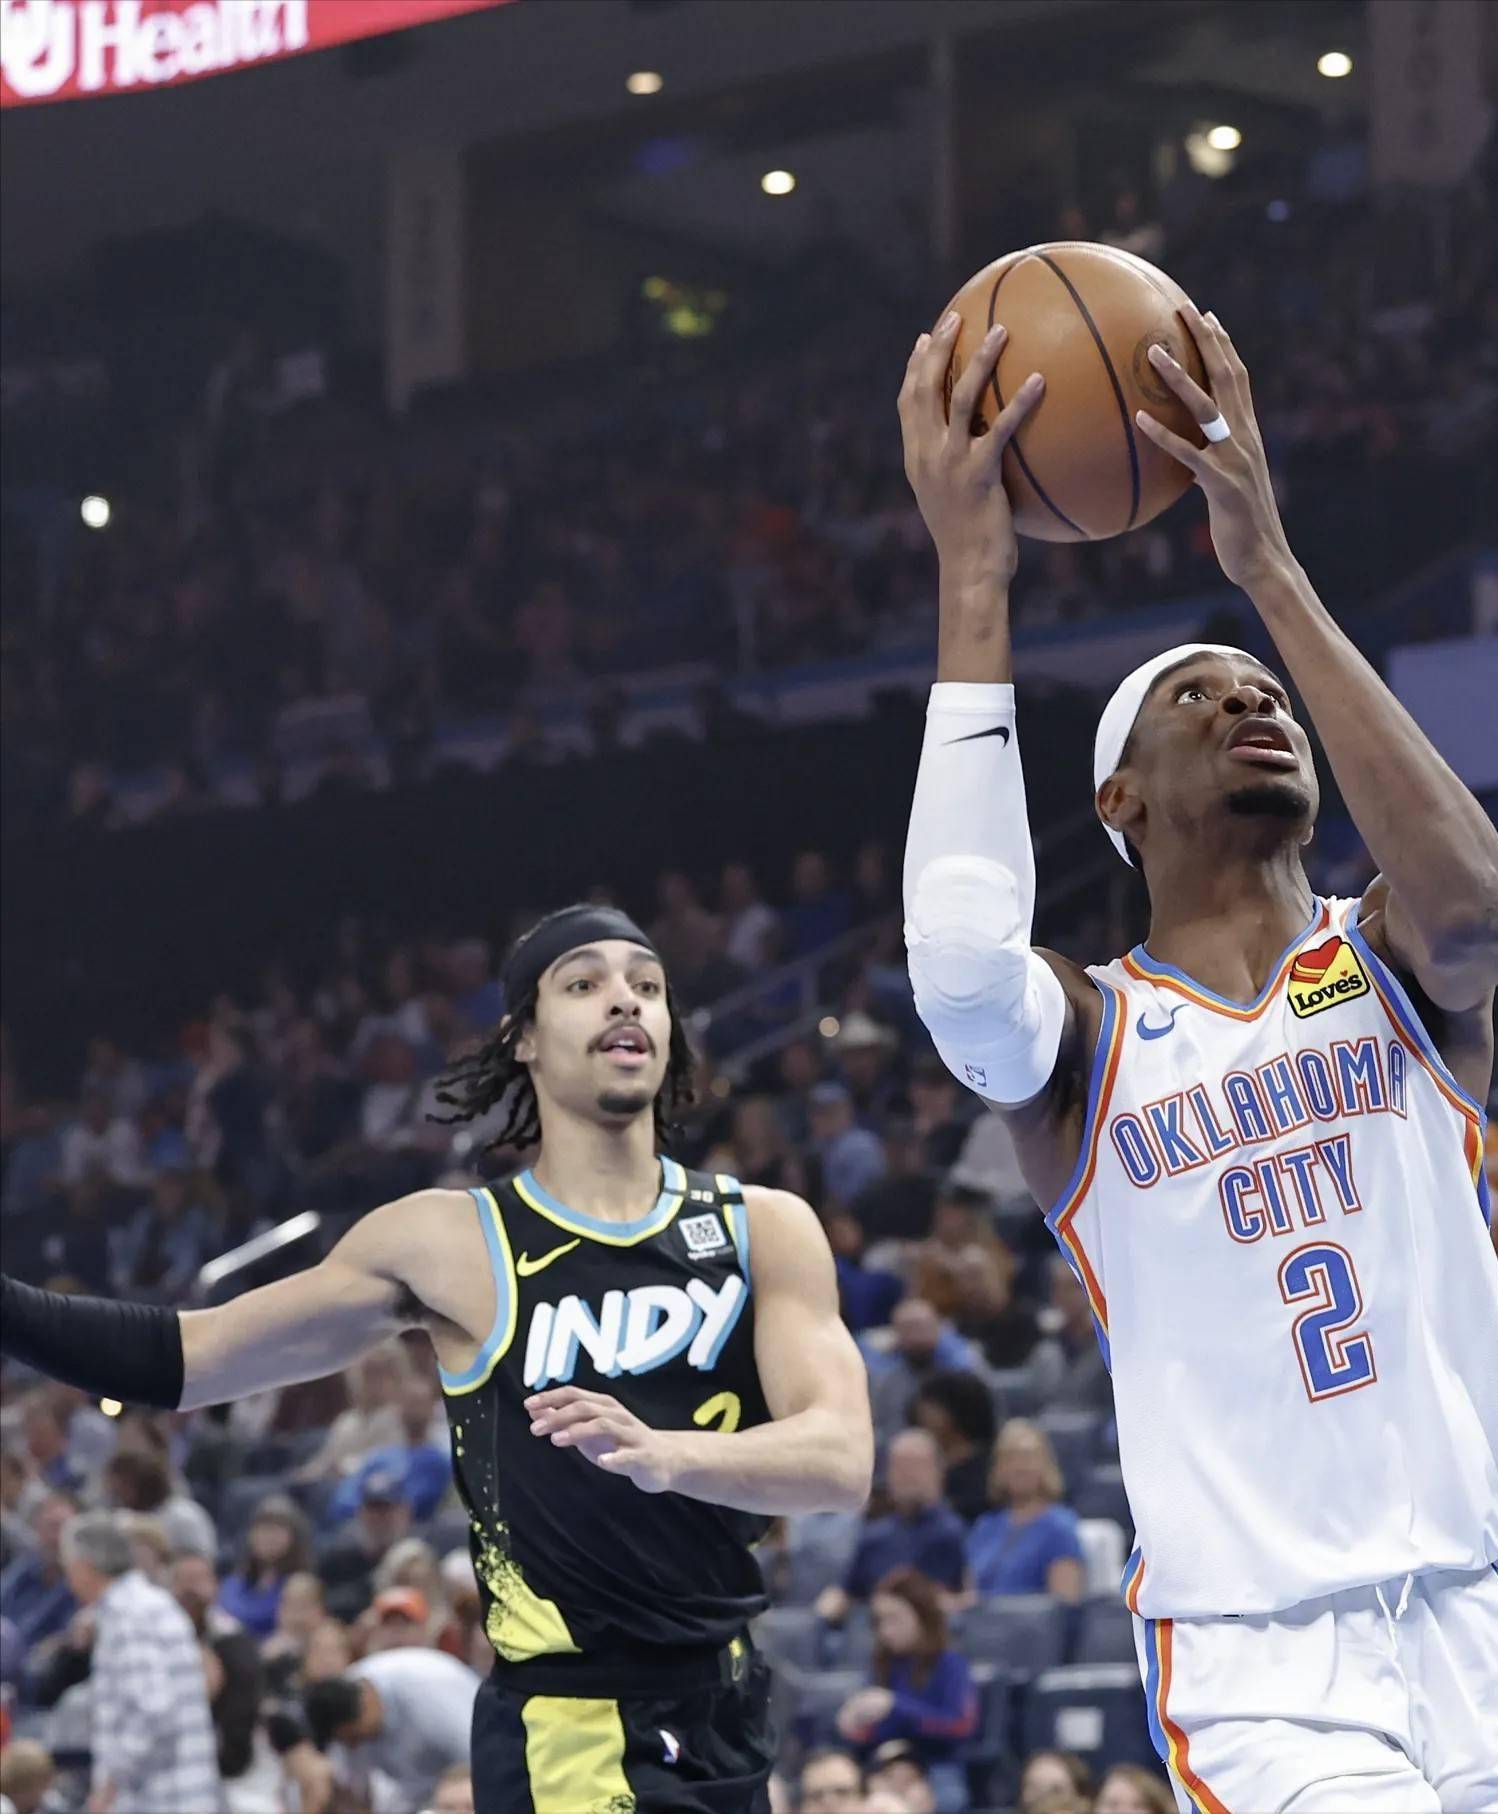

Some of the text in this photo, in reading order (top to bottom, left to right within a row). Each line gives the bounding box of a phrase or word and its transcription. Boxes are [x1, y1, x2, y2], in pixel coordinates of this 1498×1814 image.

[1109, 1036, 1408, 1190] OKLAHOMA
[1218, 1133, 1363, 1244] CITY
[523, 1274, 748, 1392] INDY
[1277, 1240, 1378, 1403] 2
